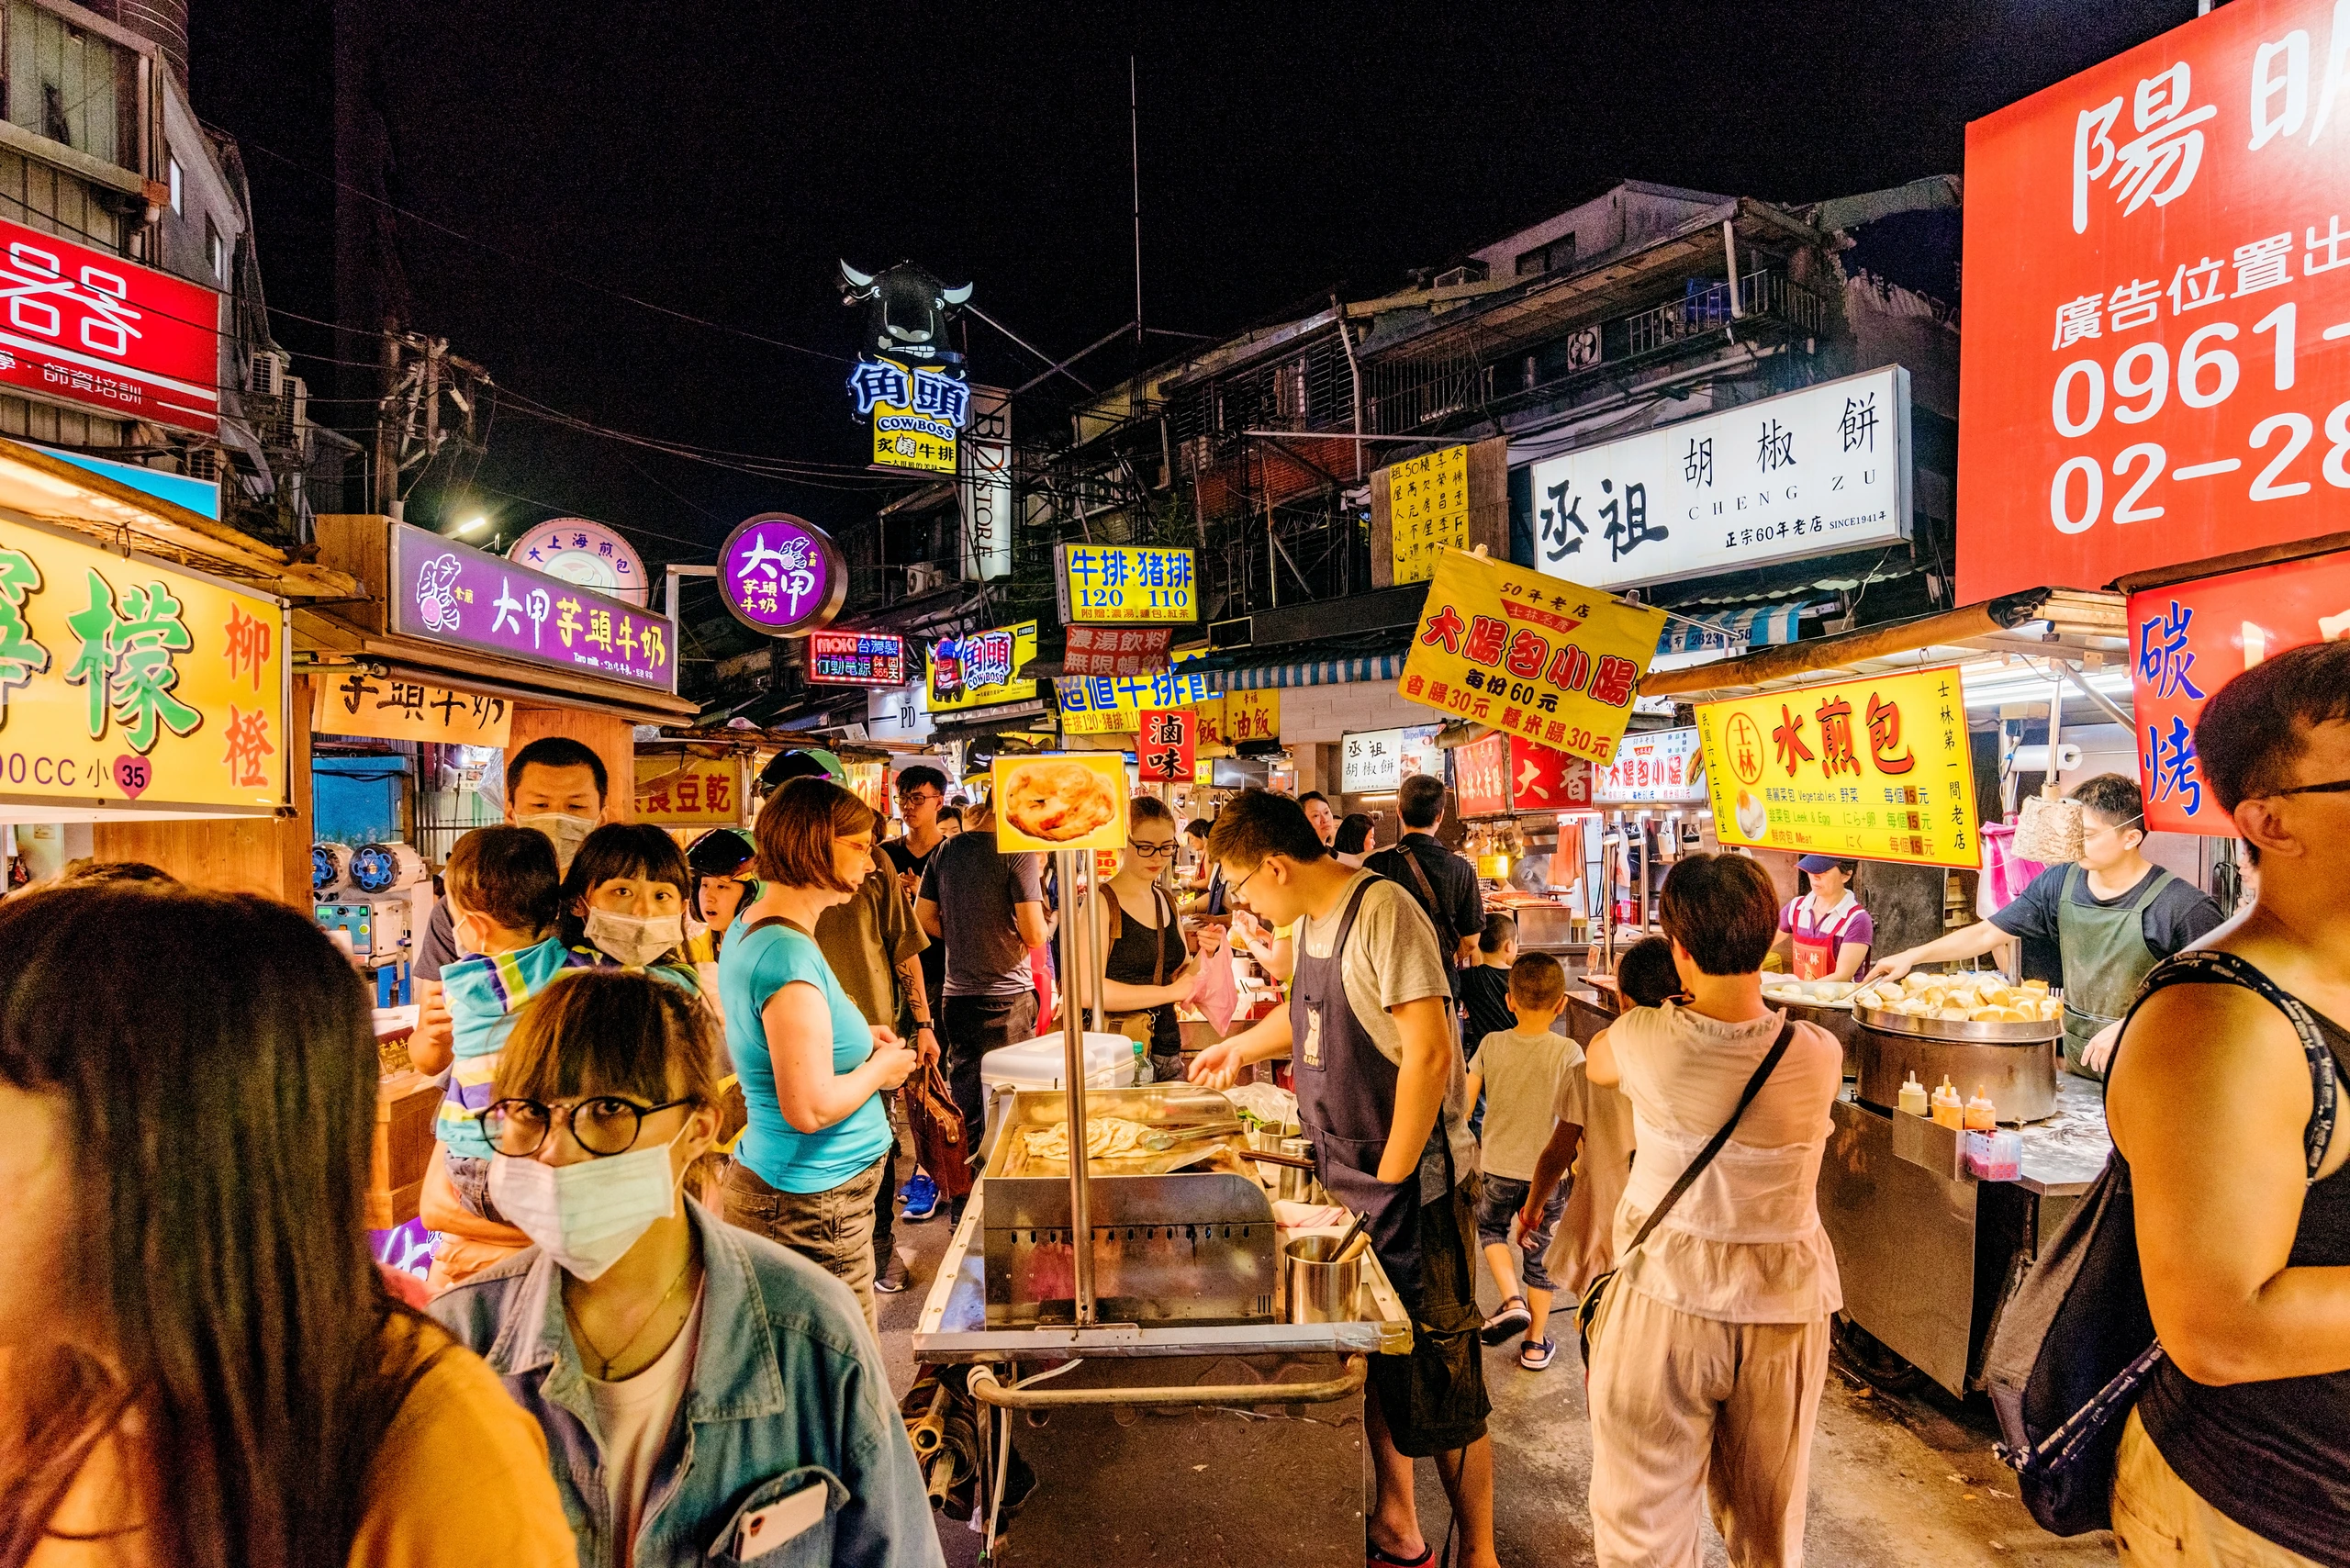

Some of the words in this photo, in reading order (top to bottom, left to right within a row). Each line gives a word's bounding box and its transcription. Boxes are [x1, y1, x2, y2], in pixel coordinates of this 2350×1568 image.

[851, 363, 970, 427] 角頭
[878, 417, 916, 431] COW
[916, 418, 956, 442] BOSS
[1683, 391, 1880, 489] 胡椒餅
[1688, 485, 1798, 521] CHENG
[1831, 468, 1876, 491] ZU
[1540, 477, 1669, 563] 丞祖
[1725, 515, 1823, 549] 正宗60年老店
[528, 532, 631, 574] 大上海煎包
[742, 578, 778, 597] 芋頭
[1080, 588, 1124, 607] 120
[1148, 589, 1188, 608] 110
[1499, 581, 1591, 619] 50年老店
[740, 597, 778, 614] 牛奶
[1068, 628, 1168, 652] 濃湯飲料
[1421, 604, 1639, 709] 大腸包小腸
[817, 654, 871, 676] 行動電源
[1065, 650, 1165, 676] 無限暢飲
[222, 600, 274, 790] 柳橙
[1465, 668, 1561, 713] 每份60元
[901, 706, 916, 728] PD
[1233, 708, 1274, 739] 油飯
[1405, 674, 1492, 719] 香腸30元
[1499, 705, 1613, 760] 糯米腸30元
[1772, 690, 1916, 778] 水煎包
[1147, 713, 1188, 780] 滷味
[1348, 740, 1387, 758] 丞祖
[1732, 719, 1758, 778] 士林
[0, 752, 75, 787] 0CC
[86, 758, 109, 788] 小
[121, 764, 145, 789] 35
[1345, 757, 1395, 778] 胡椒餅
[1608, 755, 1683, 788] 大腸包小腸
[1937, 680, 1966, 850] 士林第一間老店
[1764, 788, 1796, 802] 高麗菜包
[1797, 789, 1837, 803] Vegetables
[1840, 787, 1859, 803] 野菜
[1793, 810, 1807, 823] Leek
[1818, 812, 1831, 826] Egg
[1771, 828, 1794, 844] 鮮肉包
[1795, 832, 1812, 845] Meat
[1845, 834, 1863, 849] にく
